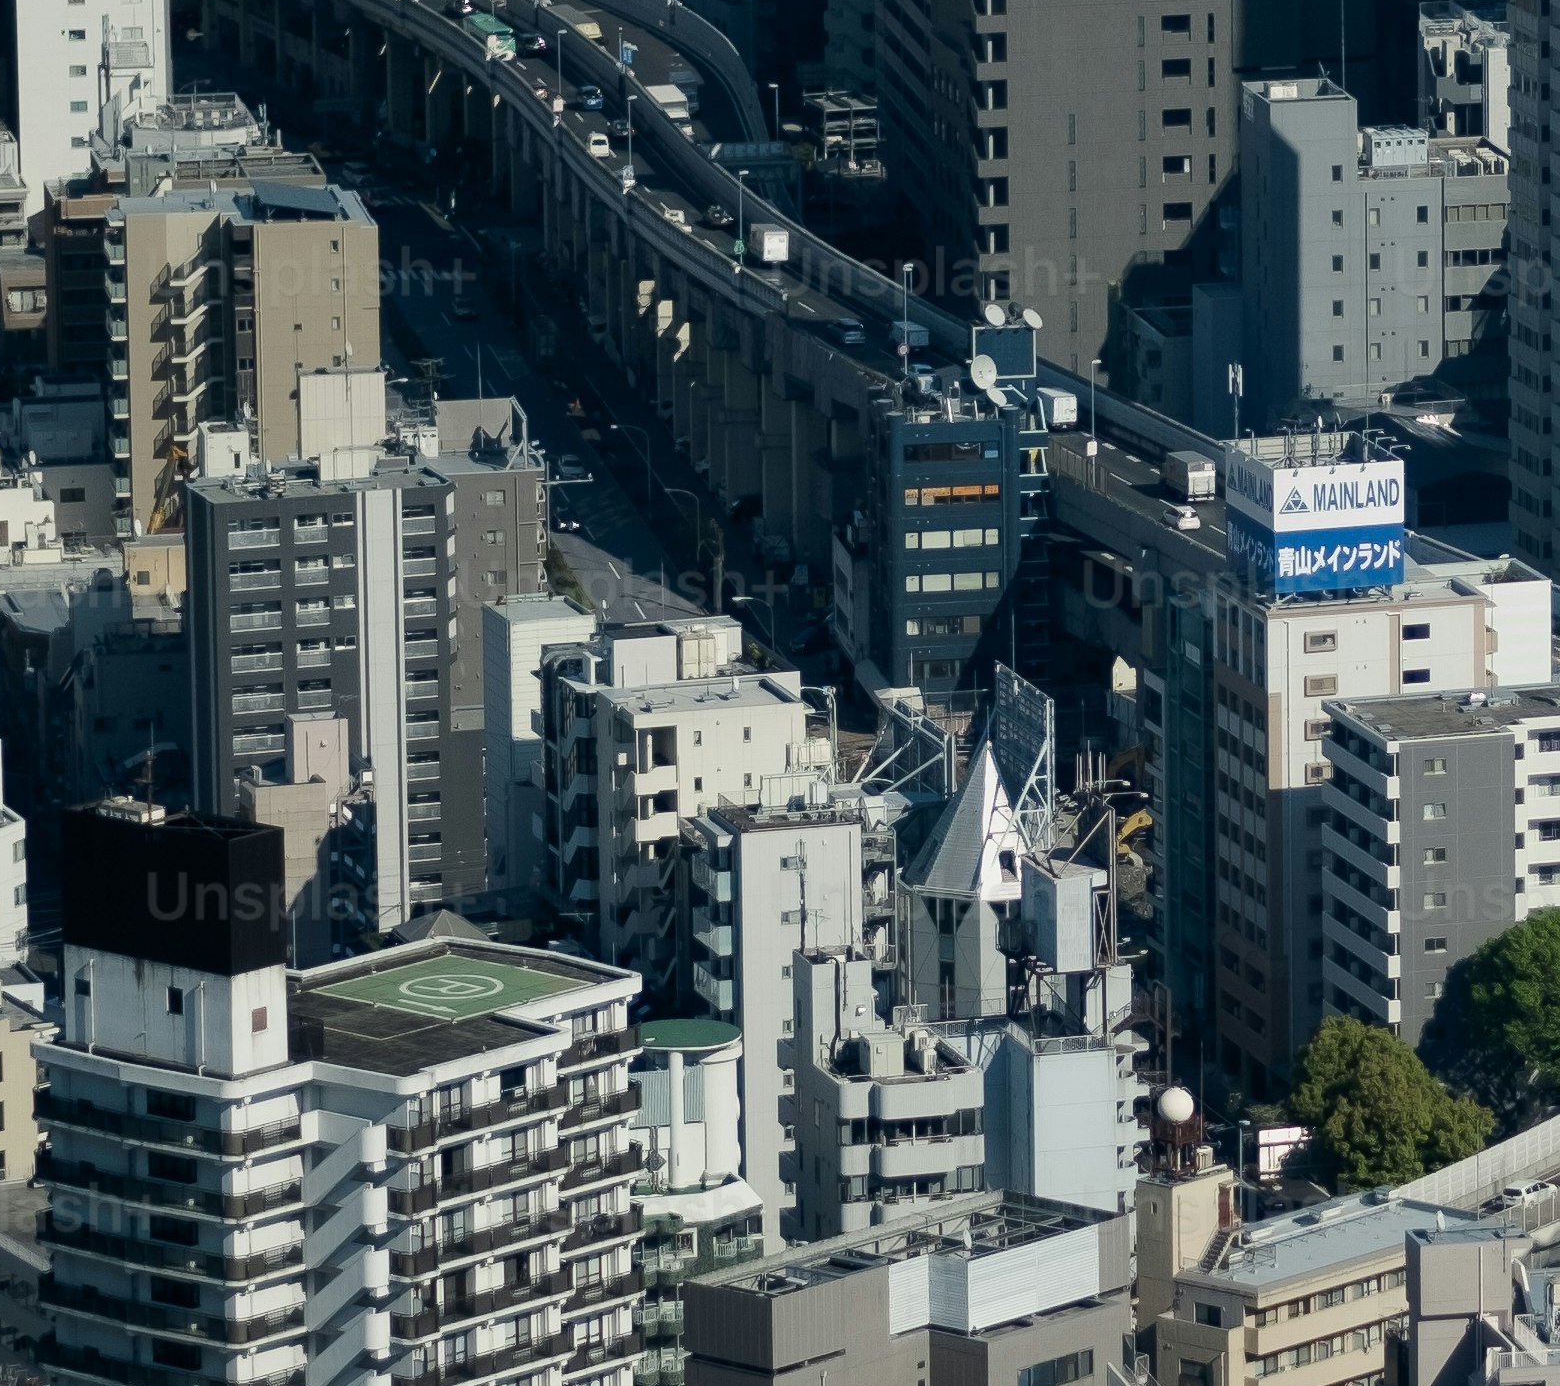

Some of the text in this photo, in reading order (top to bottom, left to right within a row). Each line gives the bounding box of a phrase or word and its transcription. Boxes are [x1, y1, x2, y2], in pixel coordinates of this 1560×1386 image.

[1313, 475, 1400, 512] MAINLAND
[1277, 540, 1402, 578] 青山メインランド
